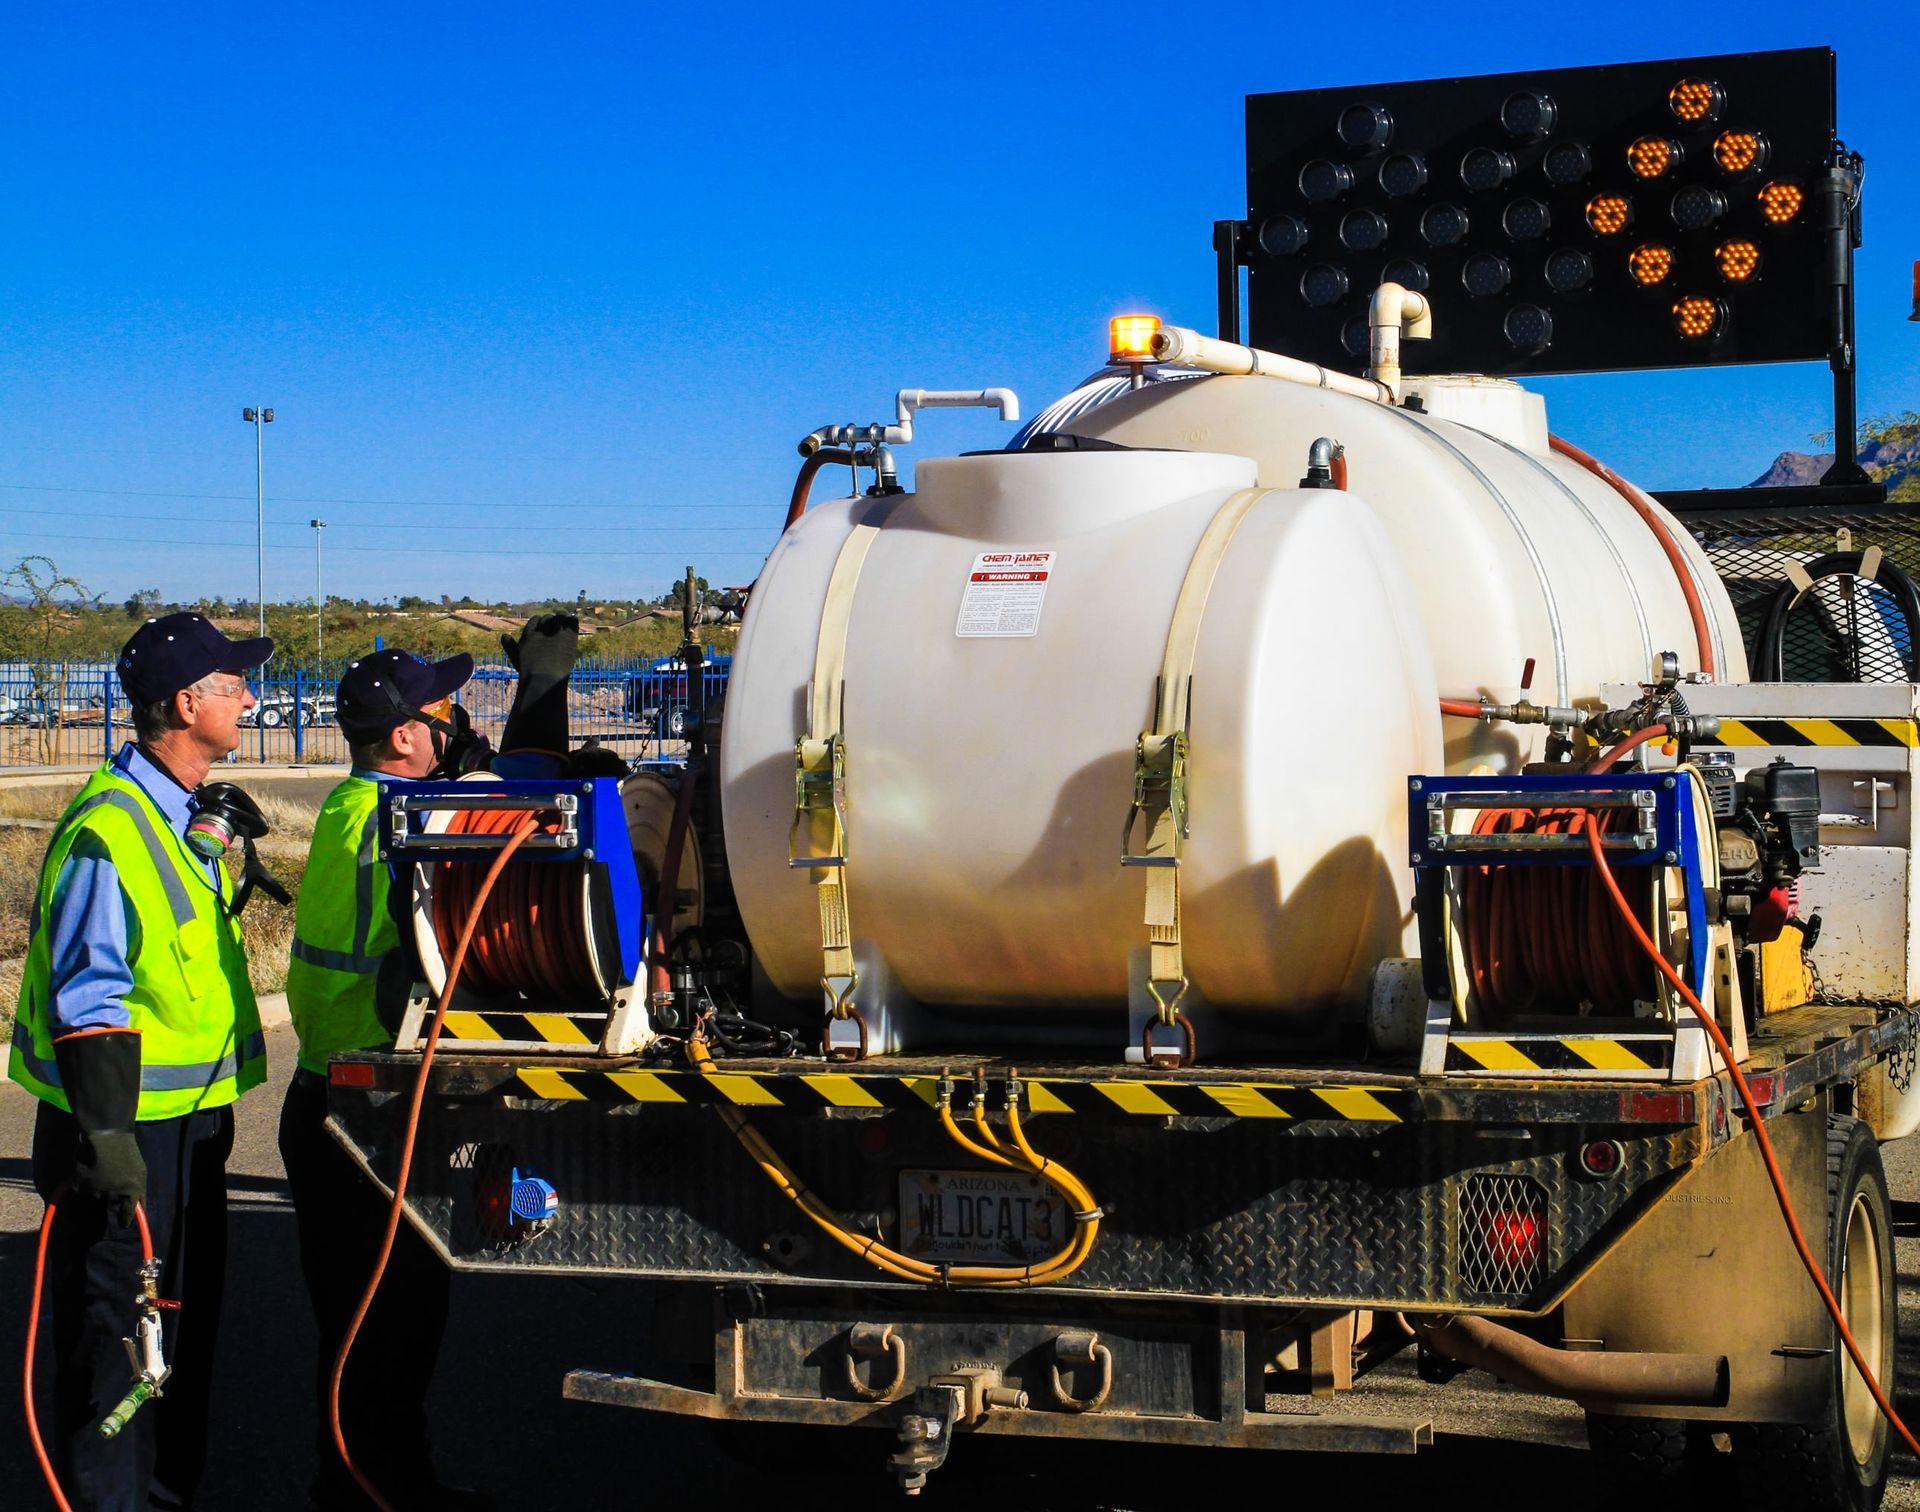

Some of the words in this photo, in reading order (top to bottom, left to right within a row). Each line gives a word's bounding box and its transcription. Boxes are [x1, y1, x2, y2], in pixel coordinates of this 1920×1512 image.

[989, 573, 1032, 581] WARNING
[948, 1178, 1021, 1191] ARIZONA
[918, 1193, 1052, 1242] WLDCAT3
